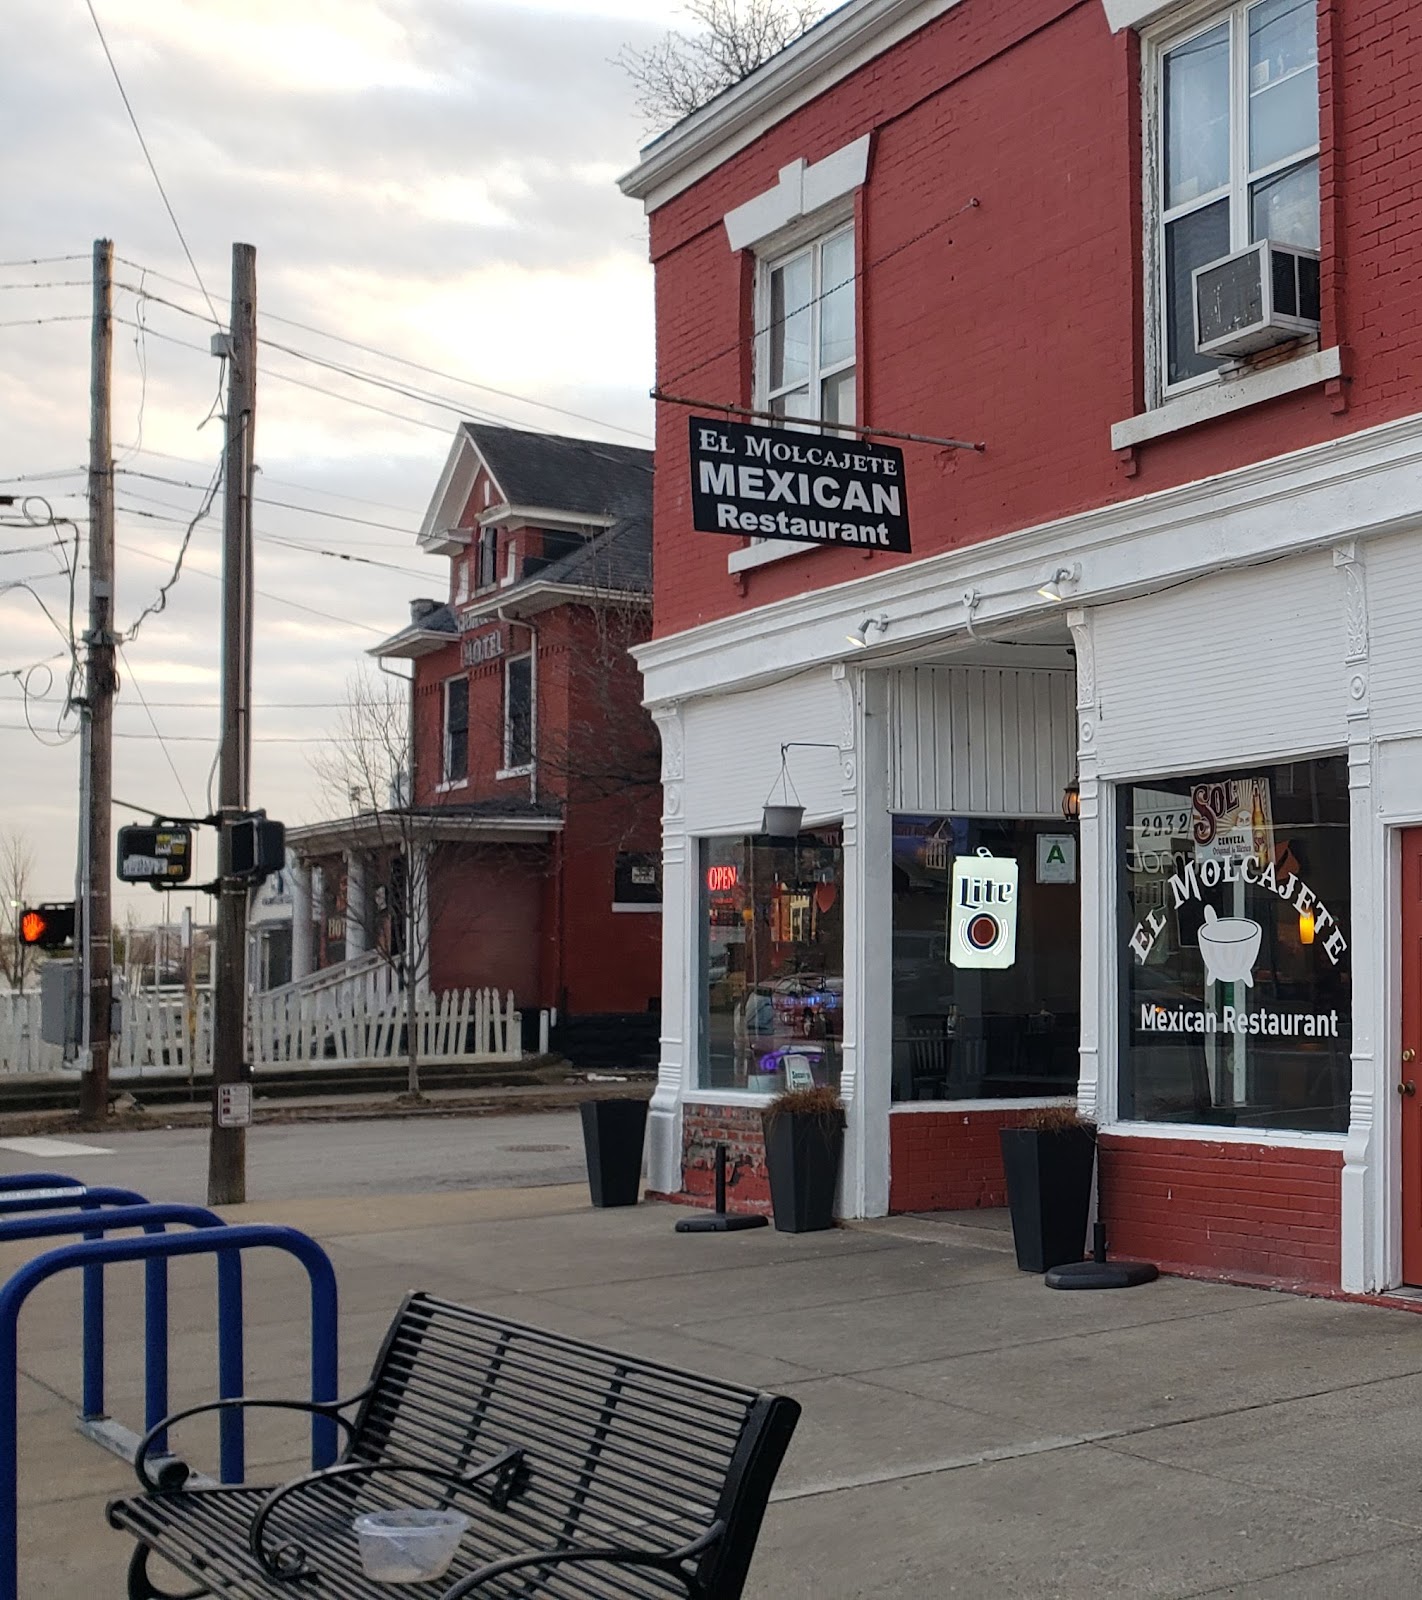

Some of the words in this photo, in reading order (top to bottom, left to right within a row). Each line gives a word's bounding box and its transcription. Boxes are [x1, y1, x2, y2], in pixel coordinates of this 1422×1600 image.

[698, 428, 735, 454] EL
[744, 435, 898, 477] MOLCAJETE
[699, 460, 901, 516] MEXICAN
[717, 502, 890, 546] Restaurant
[1140, 812, 1189, 839] 2932
[1217, 835, 1246, 846] CERVEZA
[1046, 844, 1066, 864] A
[707, 866, 736, 891] OPEN
[957, 874, 1015, 912] Lite
[1128, 909, 1168, 966] EL
[1168, 854, 1348, 966] MOLCAJETE
[1141, 1003, 1218, 1034] Mexican
[1223, 1005, 1339, 1037] Restaurant
